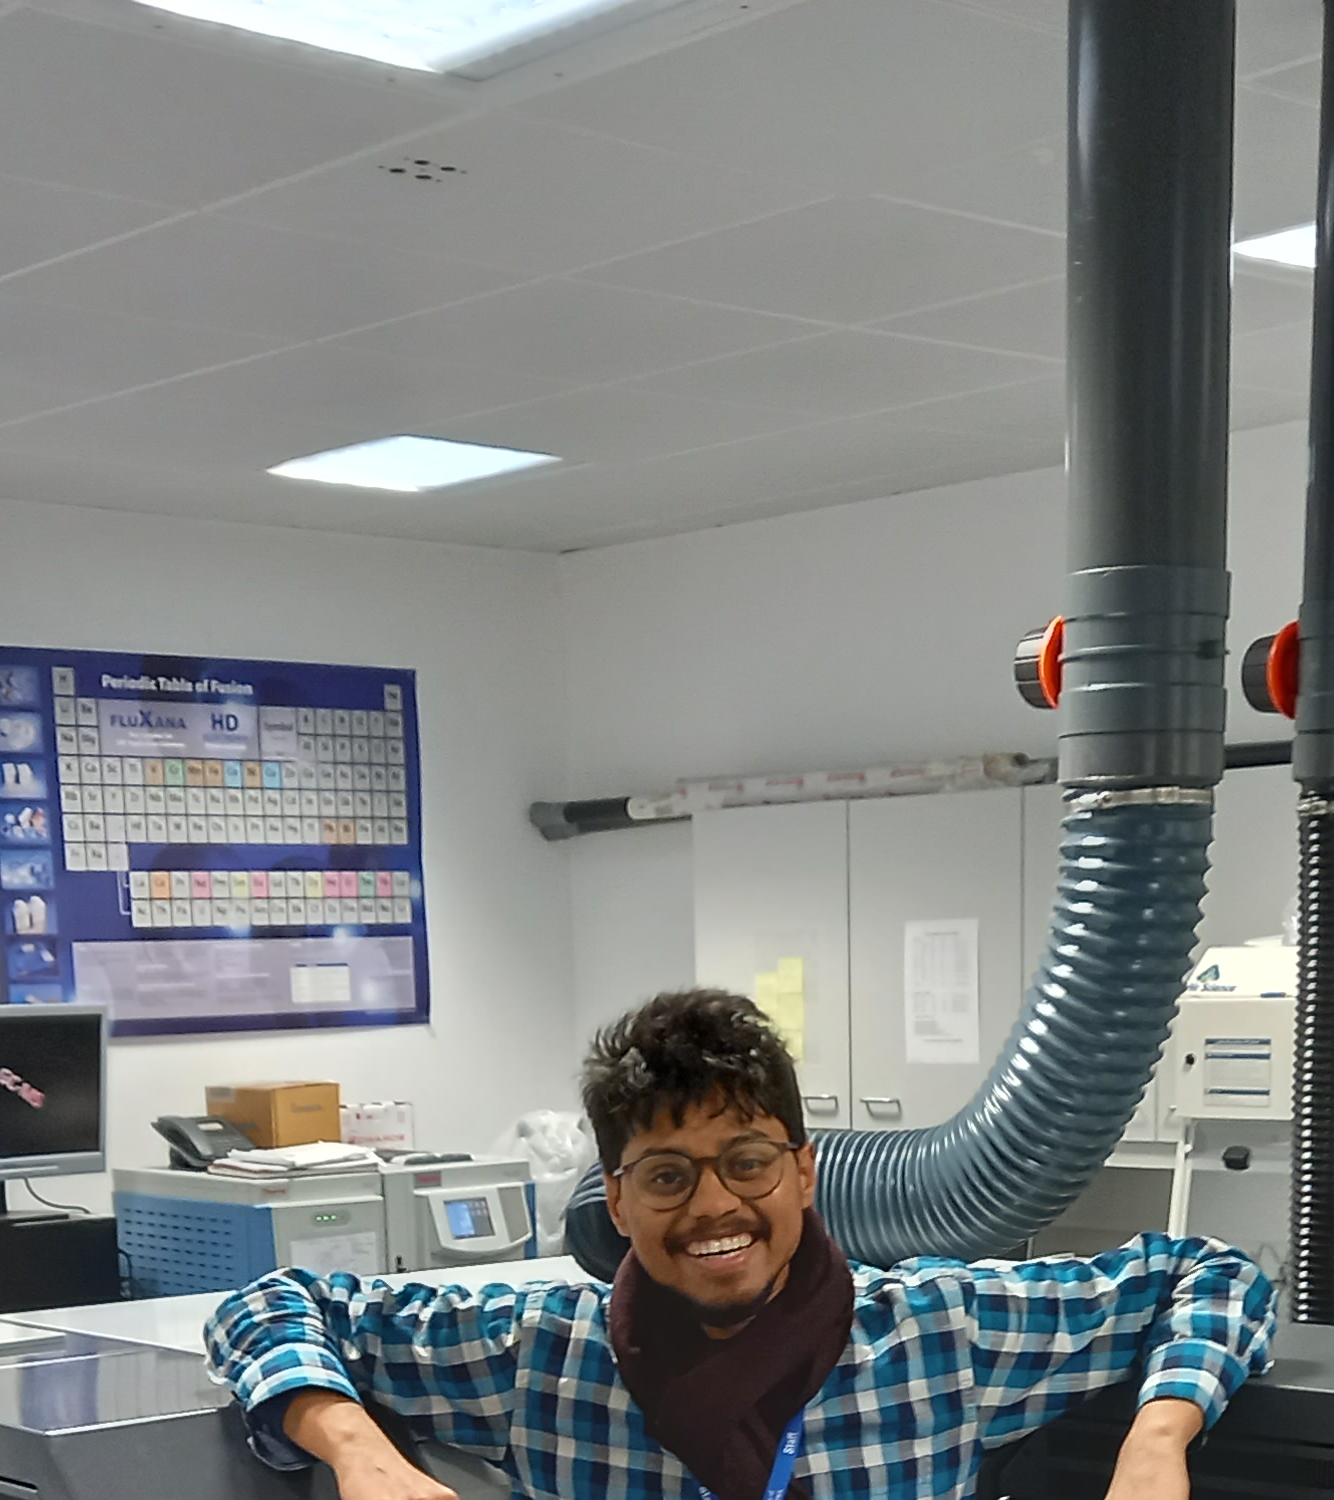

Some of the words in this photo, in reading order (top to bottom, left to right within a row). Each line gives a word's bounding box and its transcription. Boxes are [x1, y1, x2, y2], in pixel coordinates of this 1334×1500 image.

[101, 673, 157, 690] Periodic
[158, 676, 193, 693] Table
[195, 678, 209, 693] of
[211, 679, 254, 695] Fusion
[210, 713, 239, 731] HD
[782, 1431, 799, 1455] Staff
